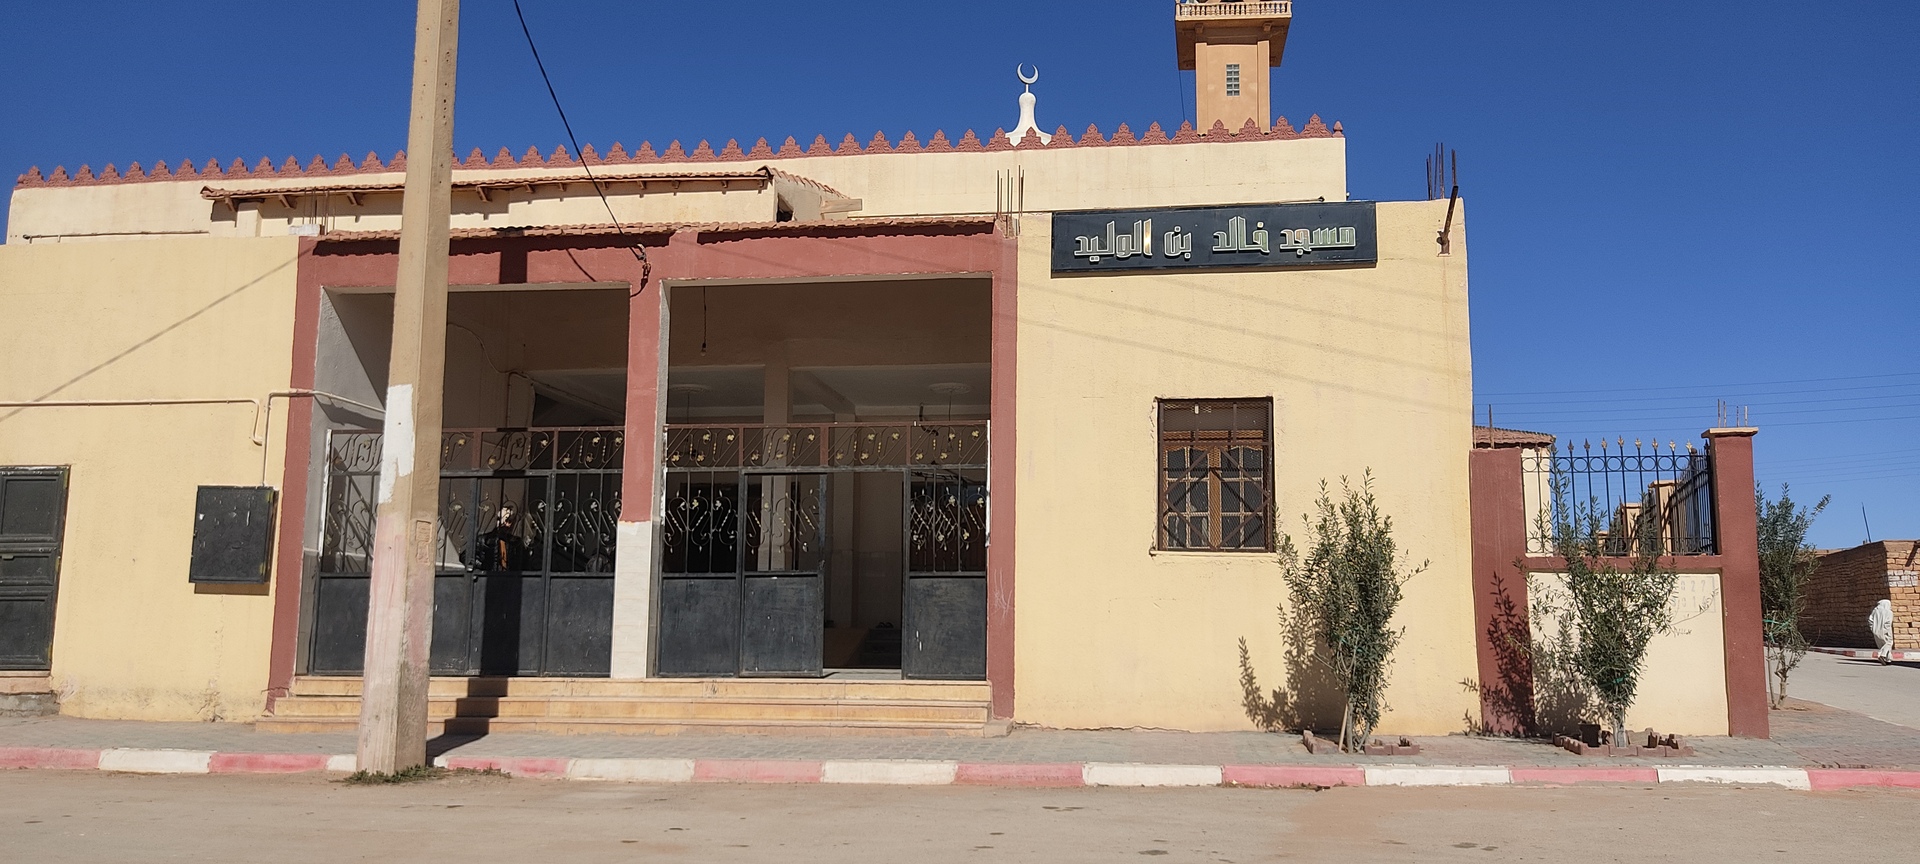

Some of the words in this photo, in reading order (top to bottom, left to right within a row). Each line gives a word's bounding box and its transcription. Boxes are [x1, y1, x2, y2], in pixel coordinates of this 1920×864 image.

[1074, 217, 1153, 263] الوليد
[1164, 225, 1192, 259] بن
[1212, 215, 1270, 254] خالد
[1279, 226, 1357, 257] مسجد
